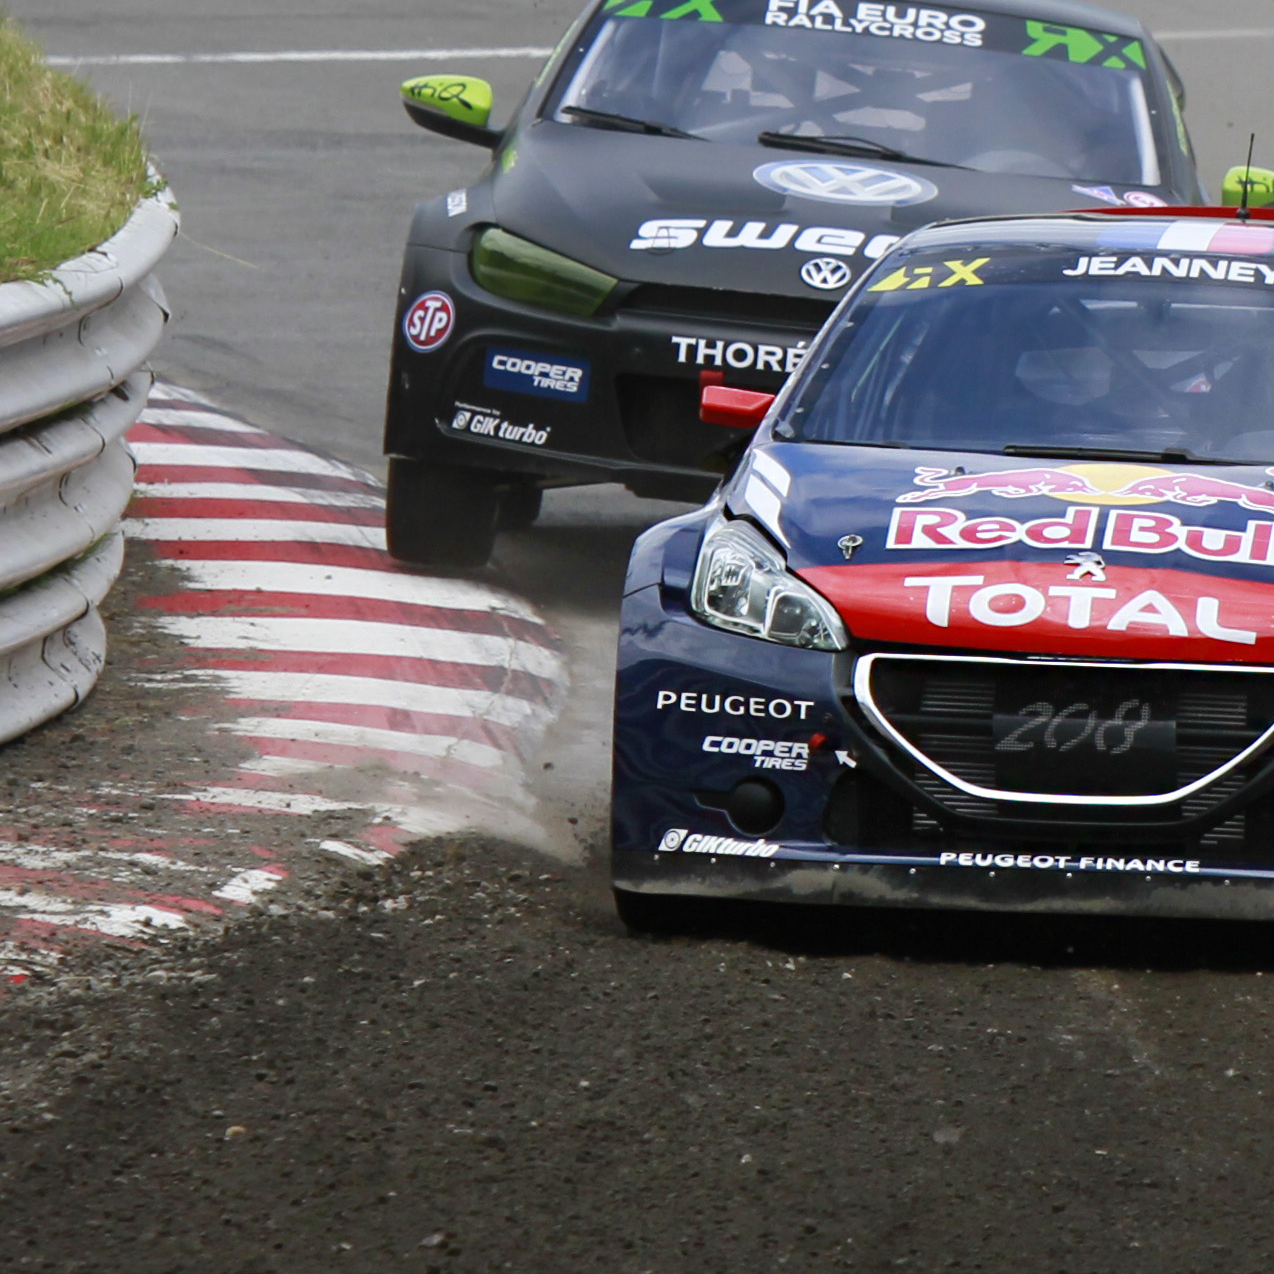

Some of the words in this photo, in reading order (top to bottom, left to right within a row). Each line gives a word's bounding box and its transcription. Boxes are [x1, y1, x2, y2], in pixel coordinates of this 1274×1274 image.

[764, 11, 984, 48] RALLYCROSS
[855, 2, 987, 33] EURO
[410, 301, 449, 343] STP
[492, 355, 583, 383] COOPER
[532, 376, 579, 394] TIRES
[470, 414, 500, 436] GIK
[498, 420, 549, 445] turbo
[887, 506, 1099, 549] Red
[903, 574, 1258, 646] TOTAL
[656, 690, 815, 720] PEUGEOT
[994, 698, 1151, 754] 208
[702, 735, 810, 759] COOPER
[753, 755, 808, 771] TIRES
[939, 851, 1071, 869] PEUGEOT
[1078, 855, 1201, 873] FINANCE
